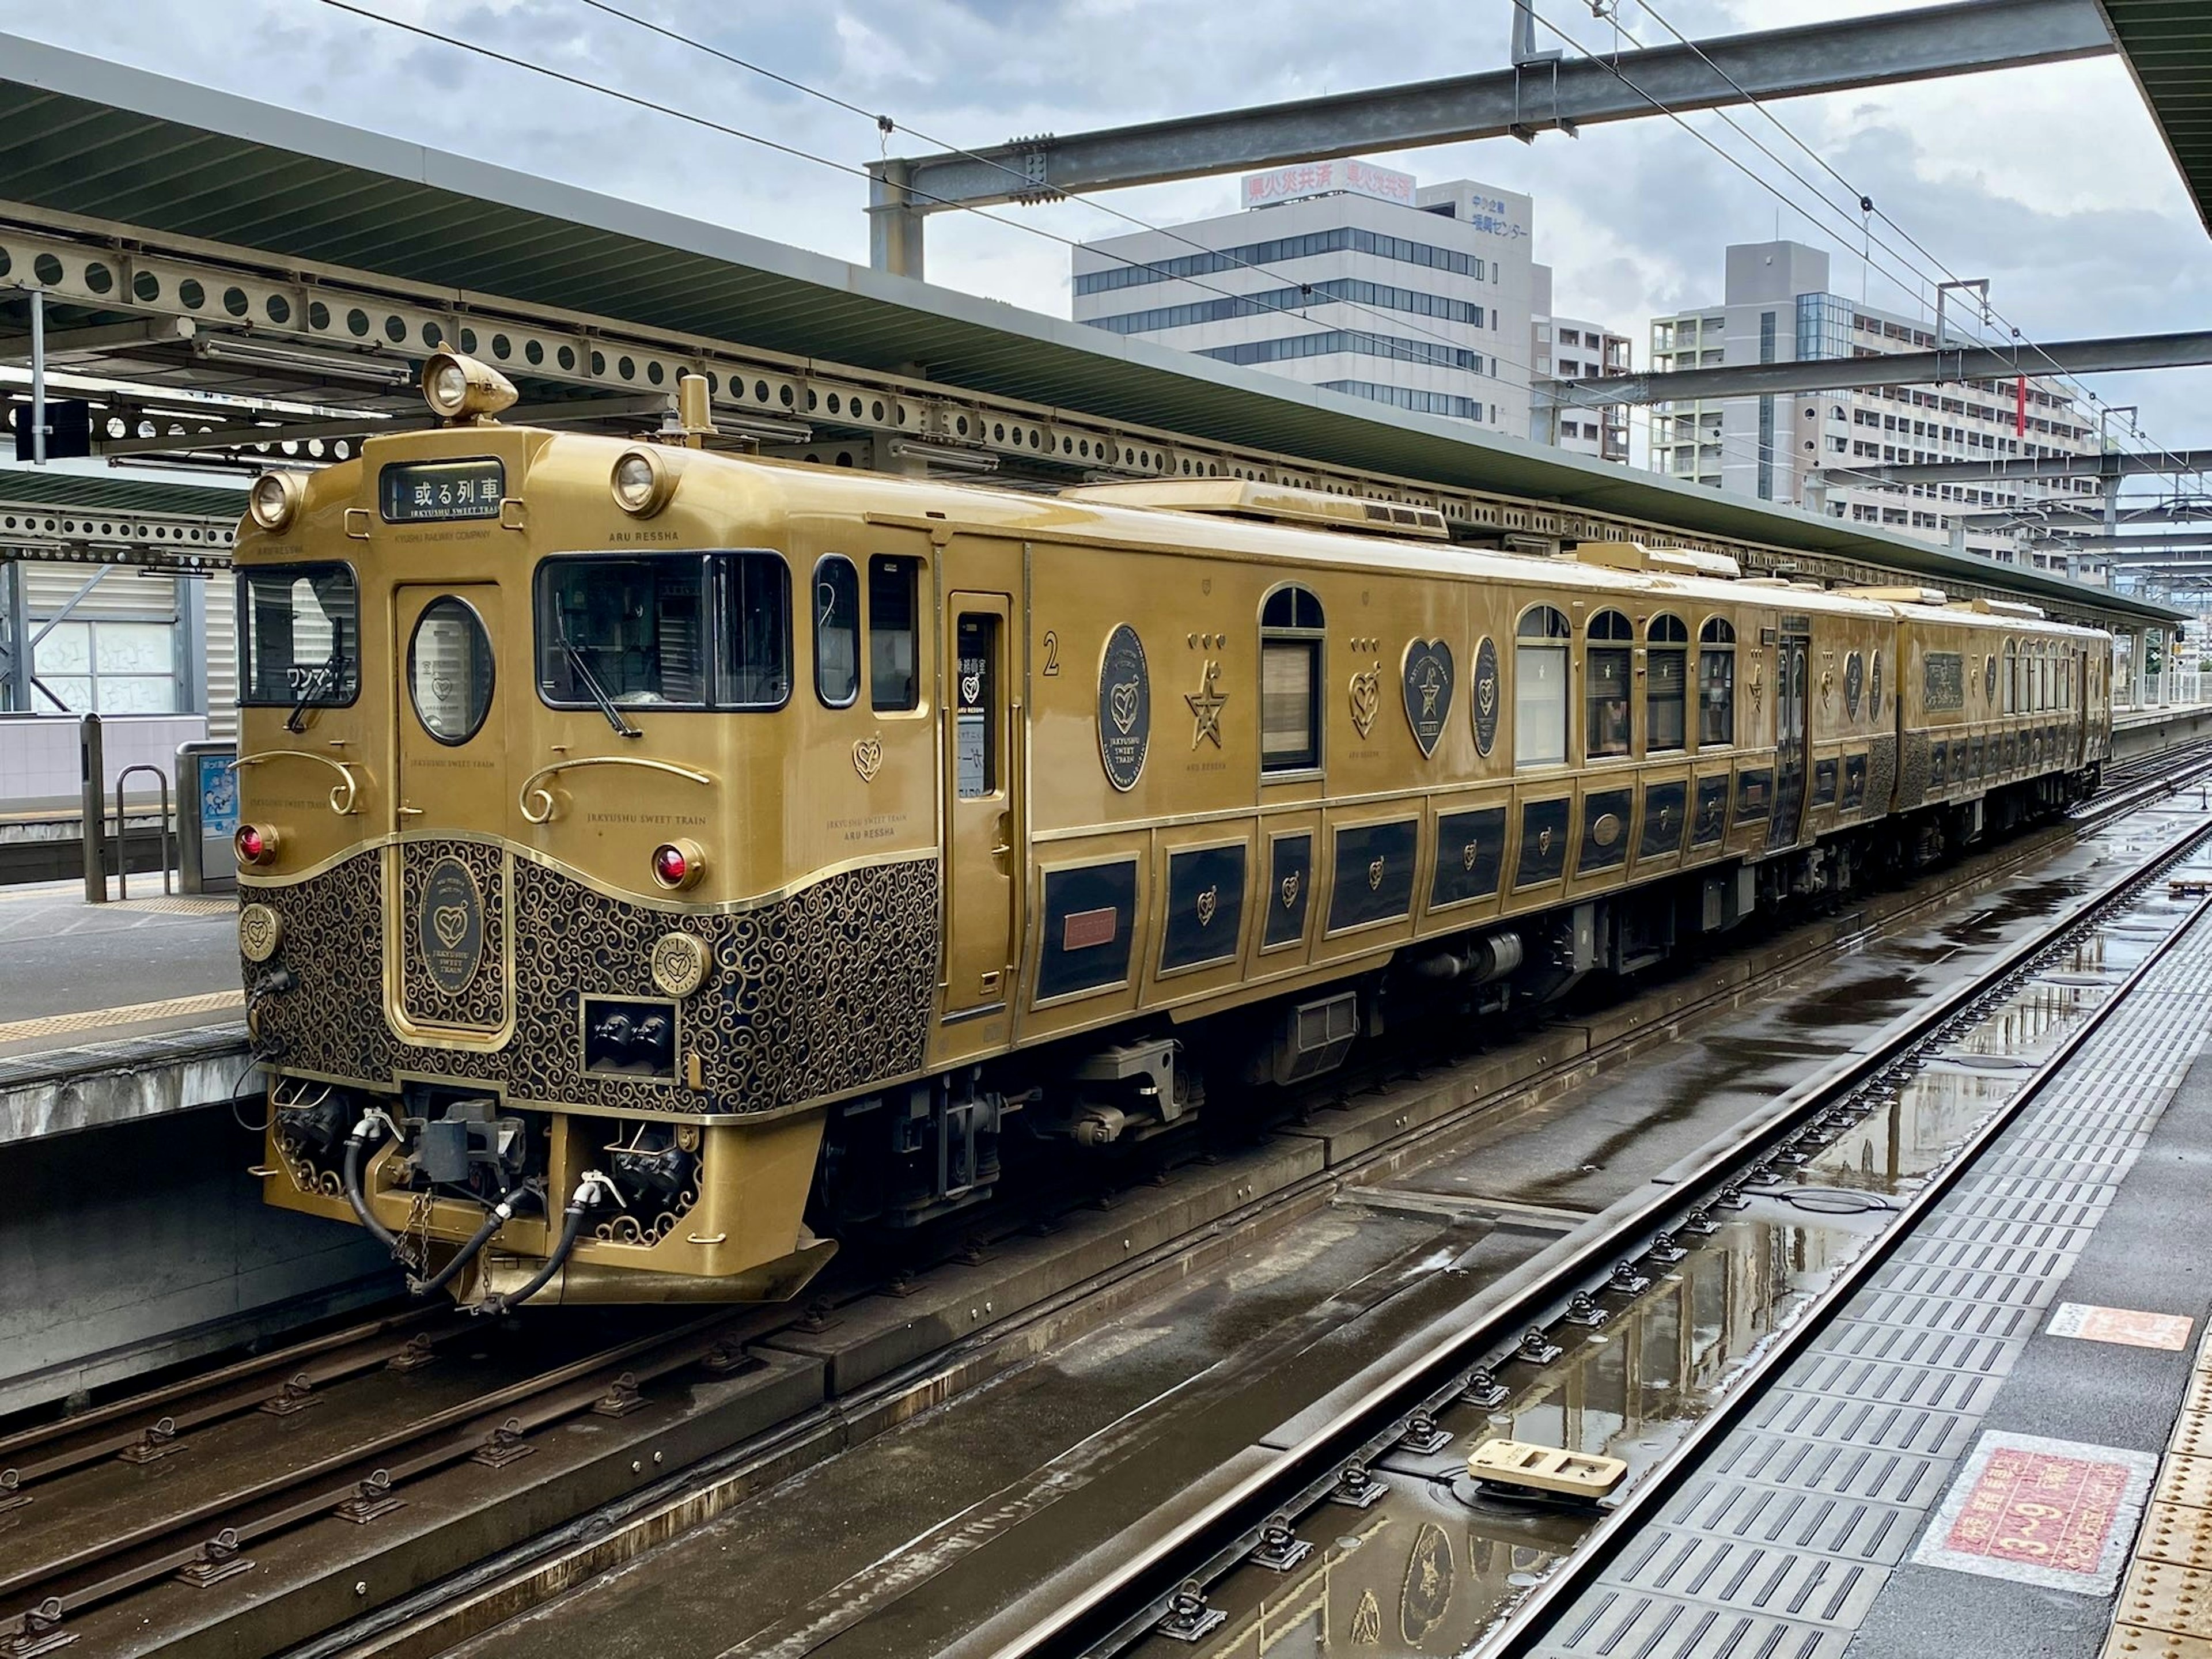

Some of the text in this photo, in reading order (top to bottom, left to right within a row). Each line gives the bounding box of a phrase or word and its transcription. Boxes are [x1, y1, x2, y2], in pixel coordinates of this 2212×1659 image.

[1249, 164, 1332, 200] 県火災共済
[1347, 164, 1410, 199] 県火災共済
[414, 477, 499, 506] 或る列車
[395, 529, 490, 543] KYUSHU RAILWAY COMPANY
[609, 531, 679, 542] ARU RESSHA
[1043, 631, 1059, 676] 2
[1115, 747, 1134, 755] SWEET
[1115, 755, 1134, 764] TRAIN
[588, 813, 707, 825] JRKYUSHU SWEET TRAIN
[864, 816, 885, 825] SWEET
[888, 813, 908, 823] TRAIN
[844, 827, 895, 840] ARU RESSHA
